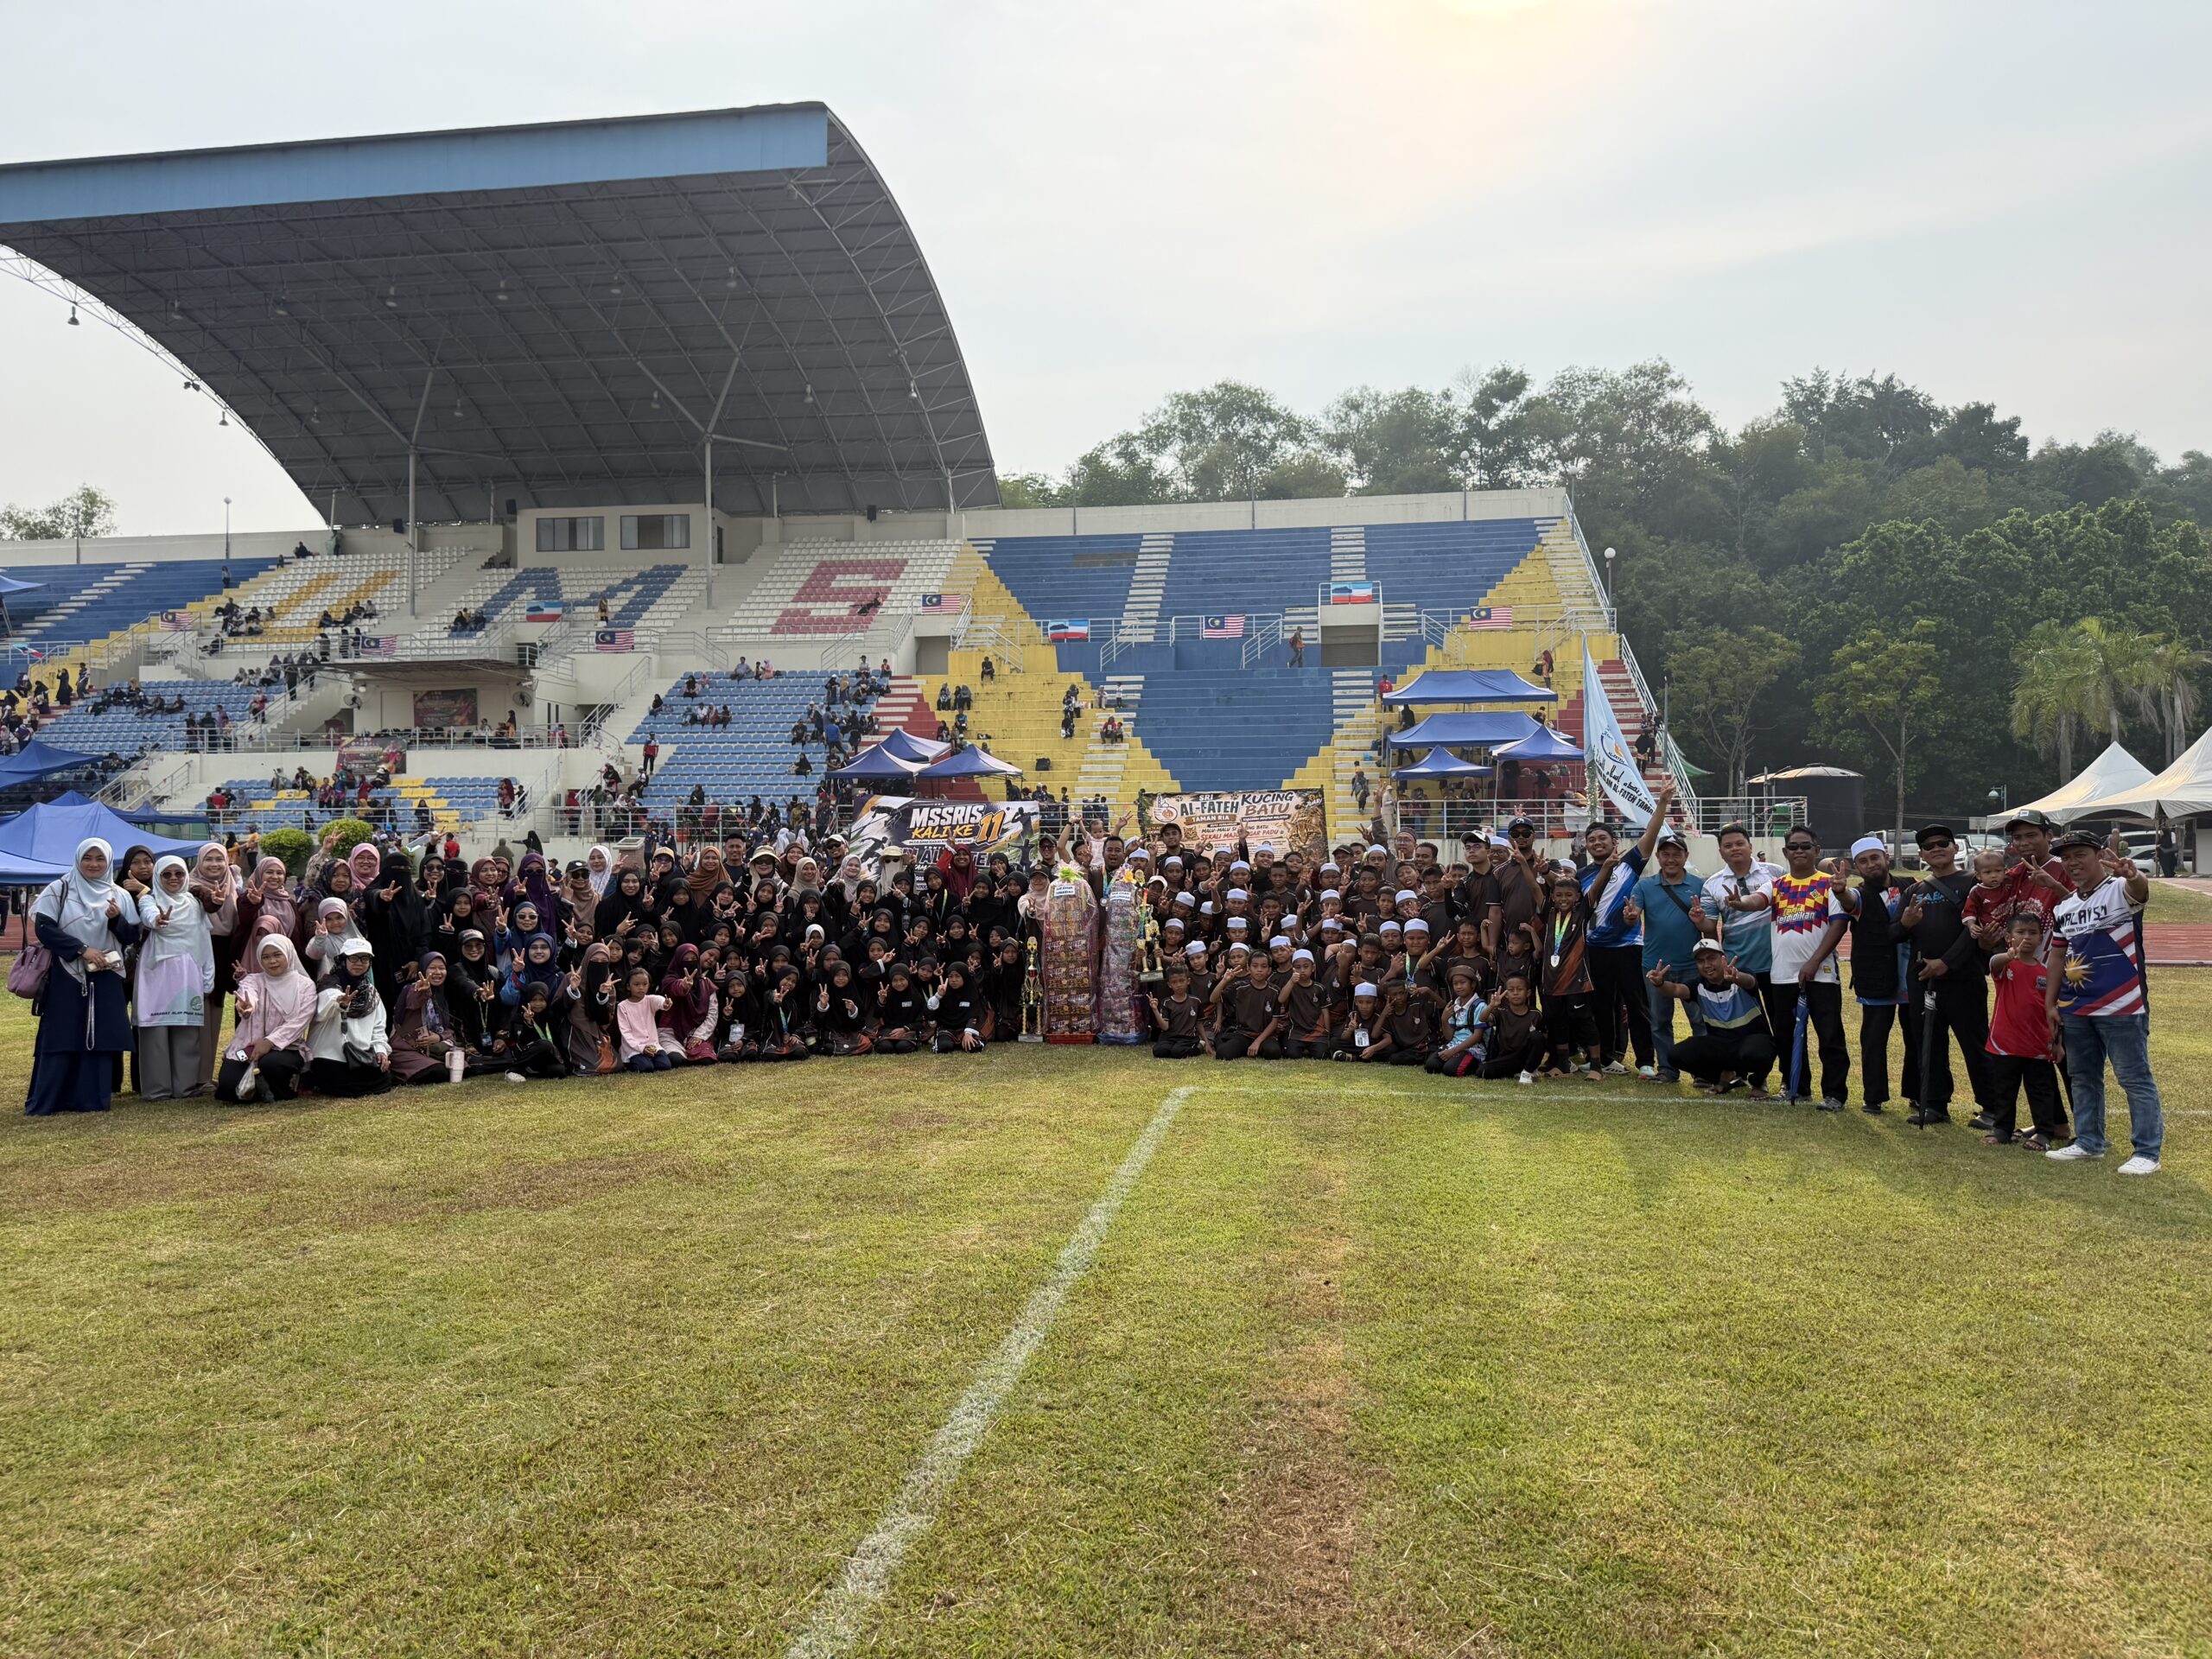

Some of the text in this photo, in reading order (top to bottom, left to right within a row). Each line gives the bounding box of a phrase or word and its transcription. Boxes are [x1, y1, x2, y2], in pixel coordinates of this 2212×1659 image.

[1241, 791, 1294, 806] KUCING
[1612, 785, 1636, 804] AL-FATEH
[1635, 798, 1655, 816] TAMA
[910, 805, 984, 828] MSSRIS
[1180, 801, 1239, 817] AL-FATEH
[1245, 803, 1290, 816] BATU
[912, 826, 950, 839] KALI
[953, 824, 975, 838] KE
[977, 810, 1006, 843] 11
